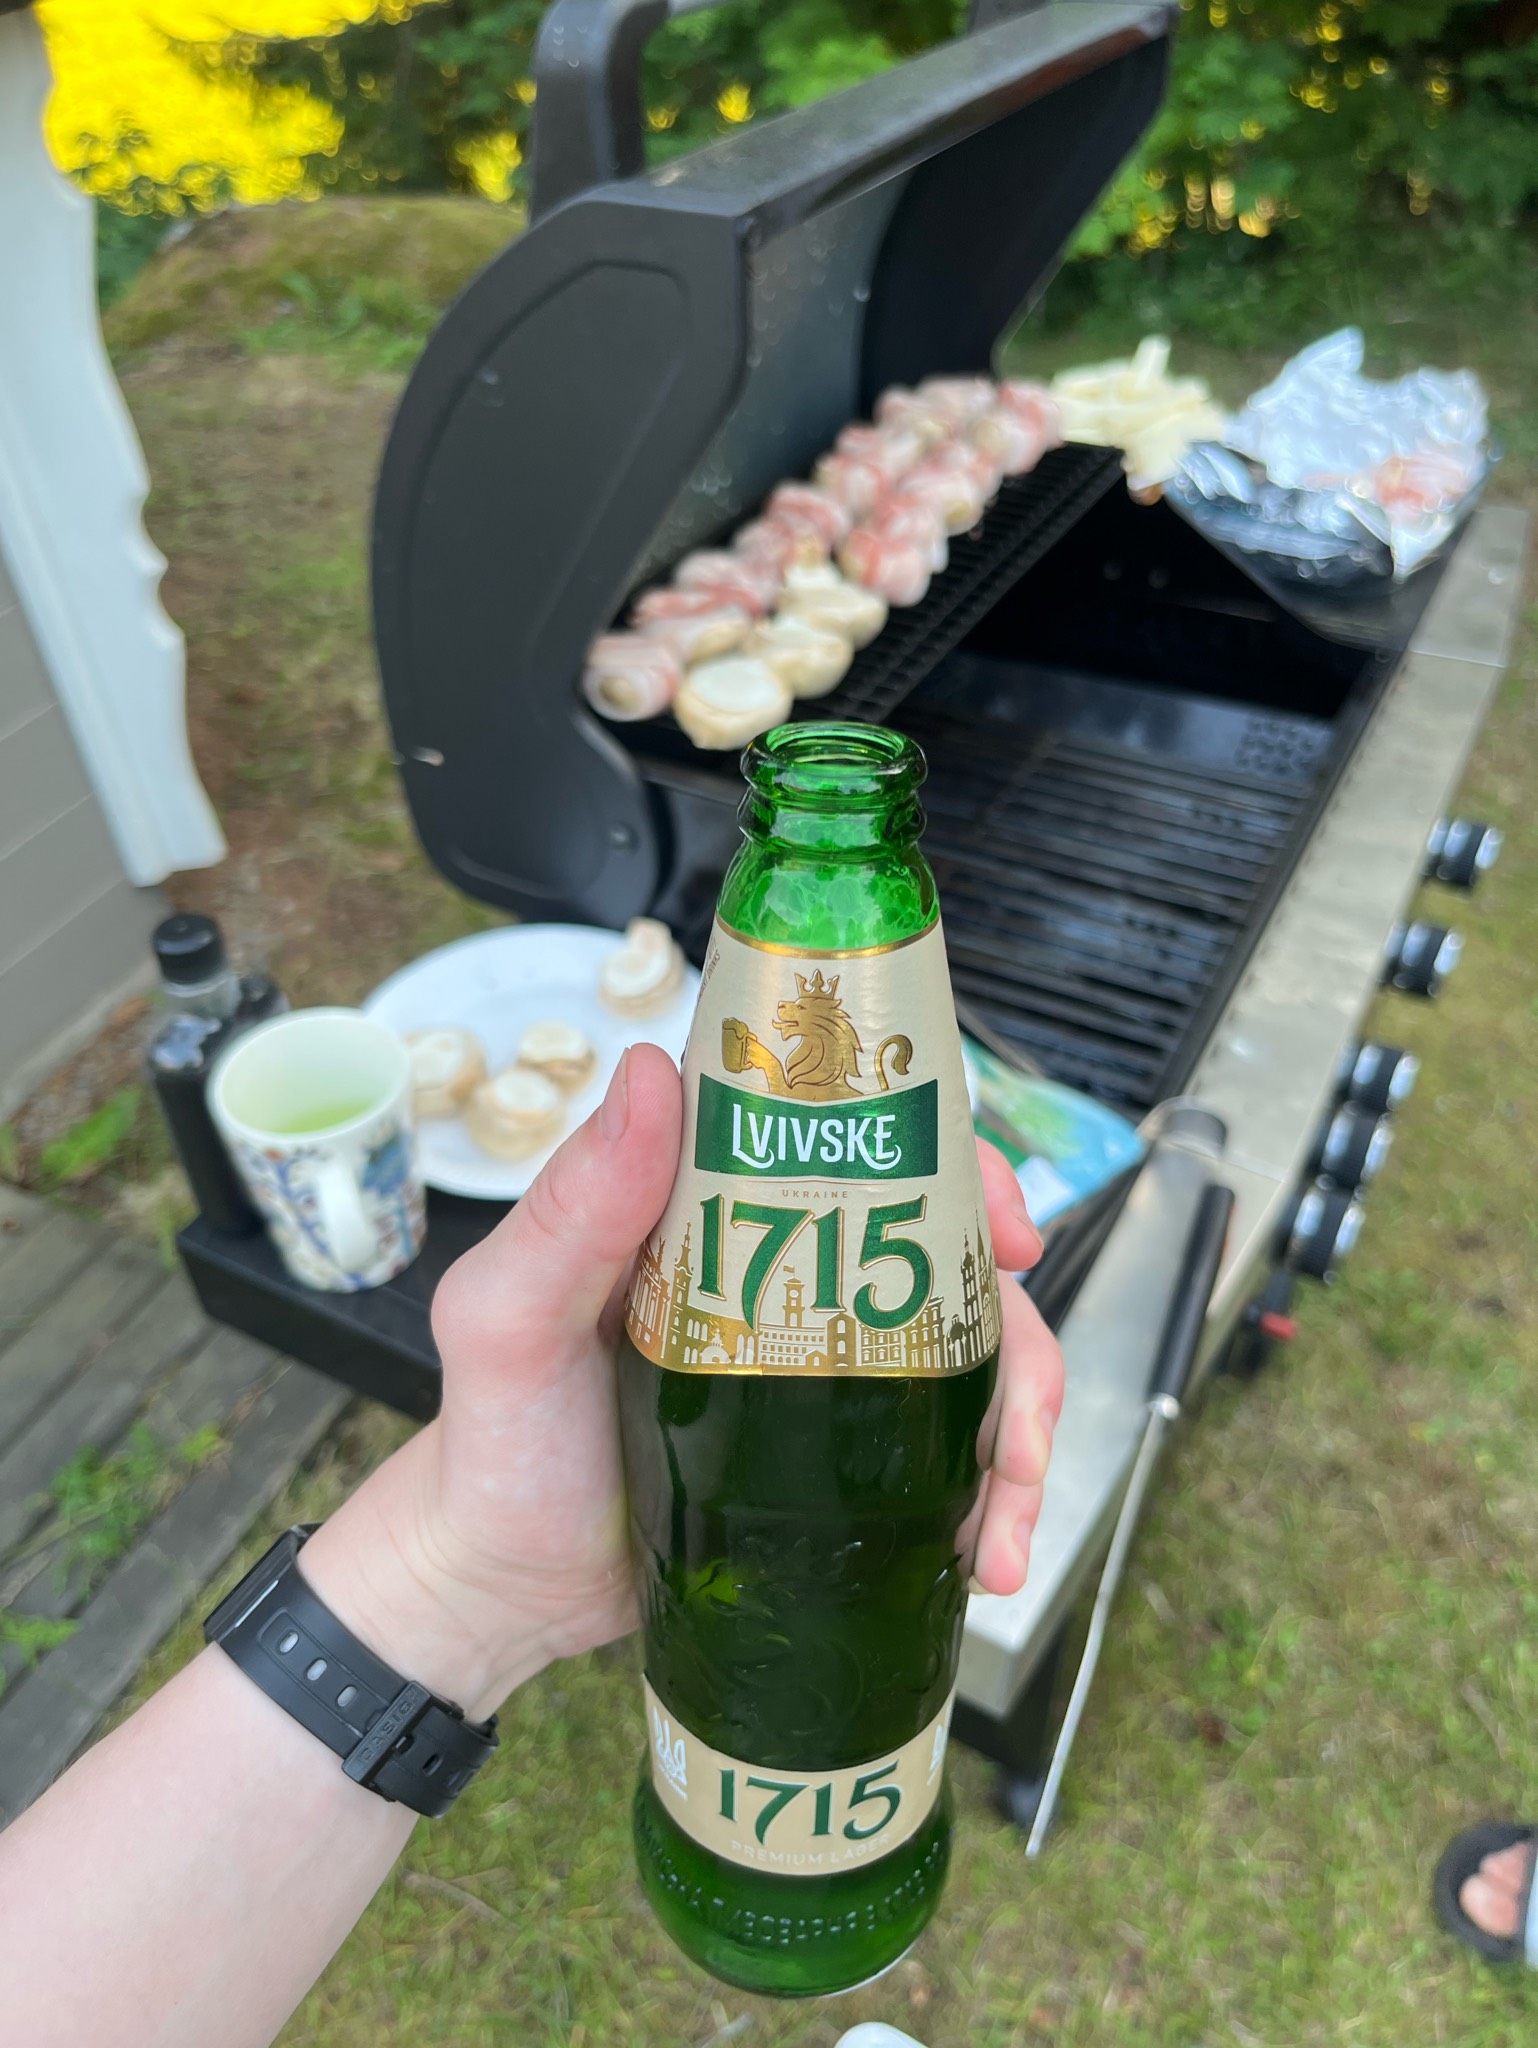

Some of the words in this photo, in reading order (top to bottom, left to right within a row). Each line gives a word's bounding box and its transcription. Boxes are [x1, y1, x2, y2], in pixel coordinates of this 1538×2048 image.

[732, 1103, 901, 1171] LVIVSKE
[782, 1189, 848, 1199] UKRAINE
[698, 1194, 933, 1333] 1715
[362, 1698, 417, 1761] CASIO
[718, 1759, 902, 1845] 1715
[731, 1840, 822, 1865] PREMIUM
[831, 1833, 890, 1863] LAGER
